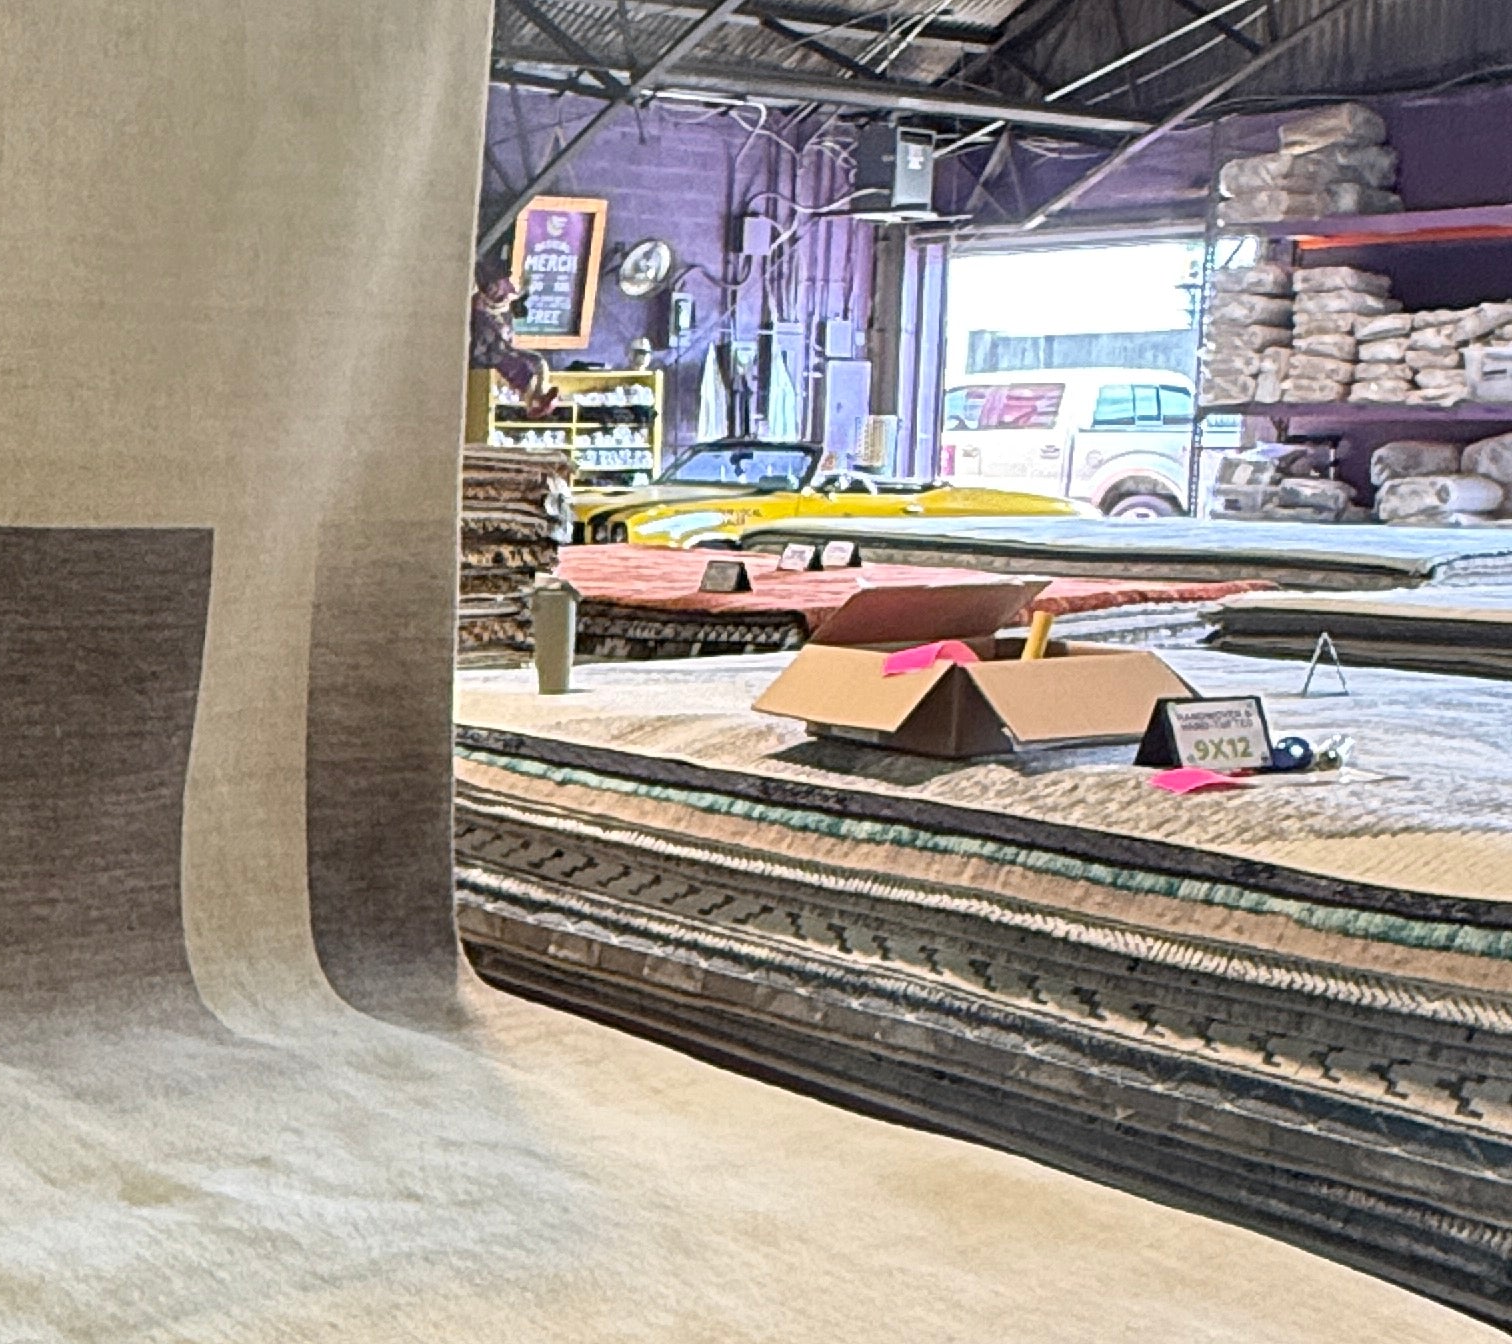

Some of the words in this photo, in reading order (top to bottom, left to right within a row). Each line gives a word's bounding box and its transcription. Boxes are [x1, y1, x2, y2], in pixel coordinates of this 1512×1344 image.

[525, 254, 577, 273] MERCH
[526, 311, 560, 324] FREE
[1194, 737, 1252, 760] 9X12
